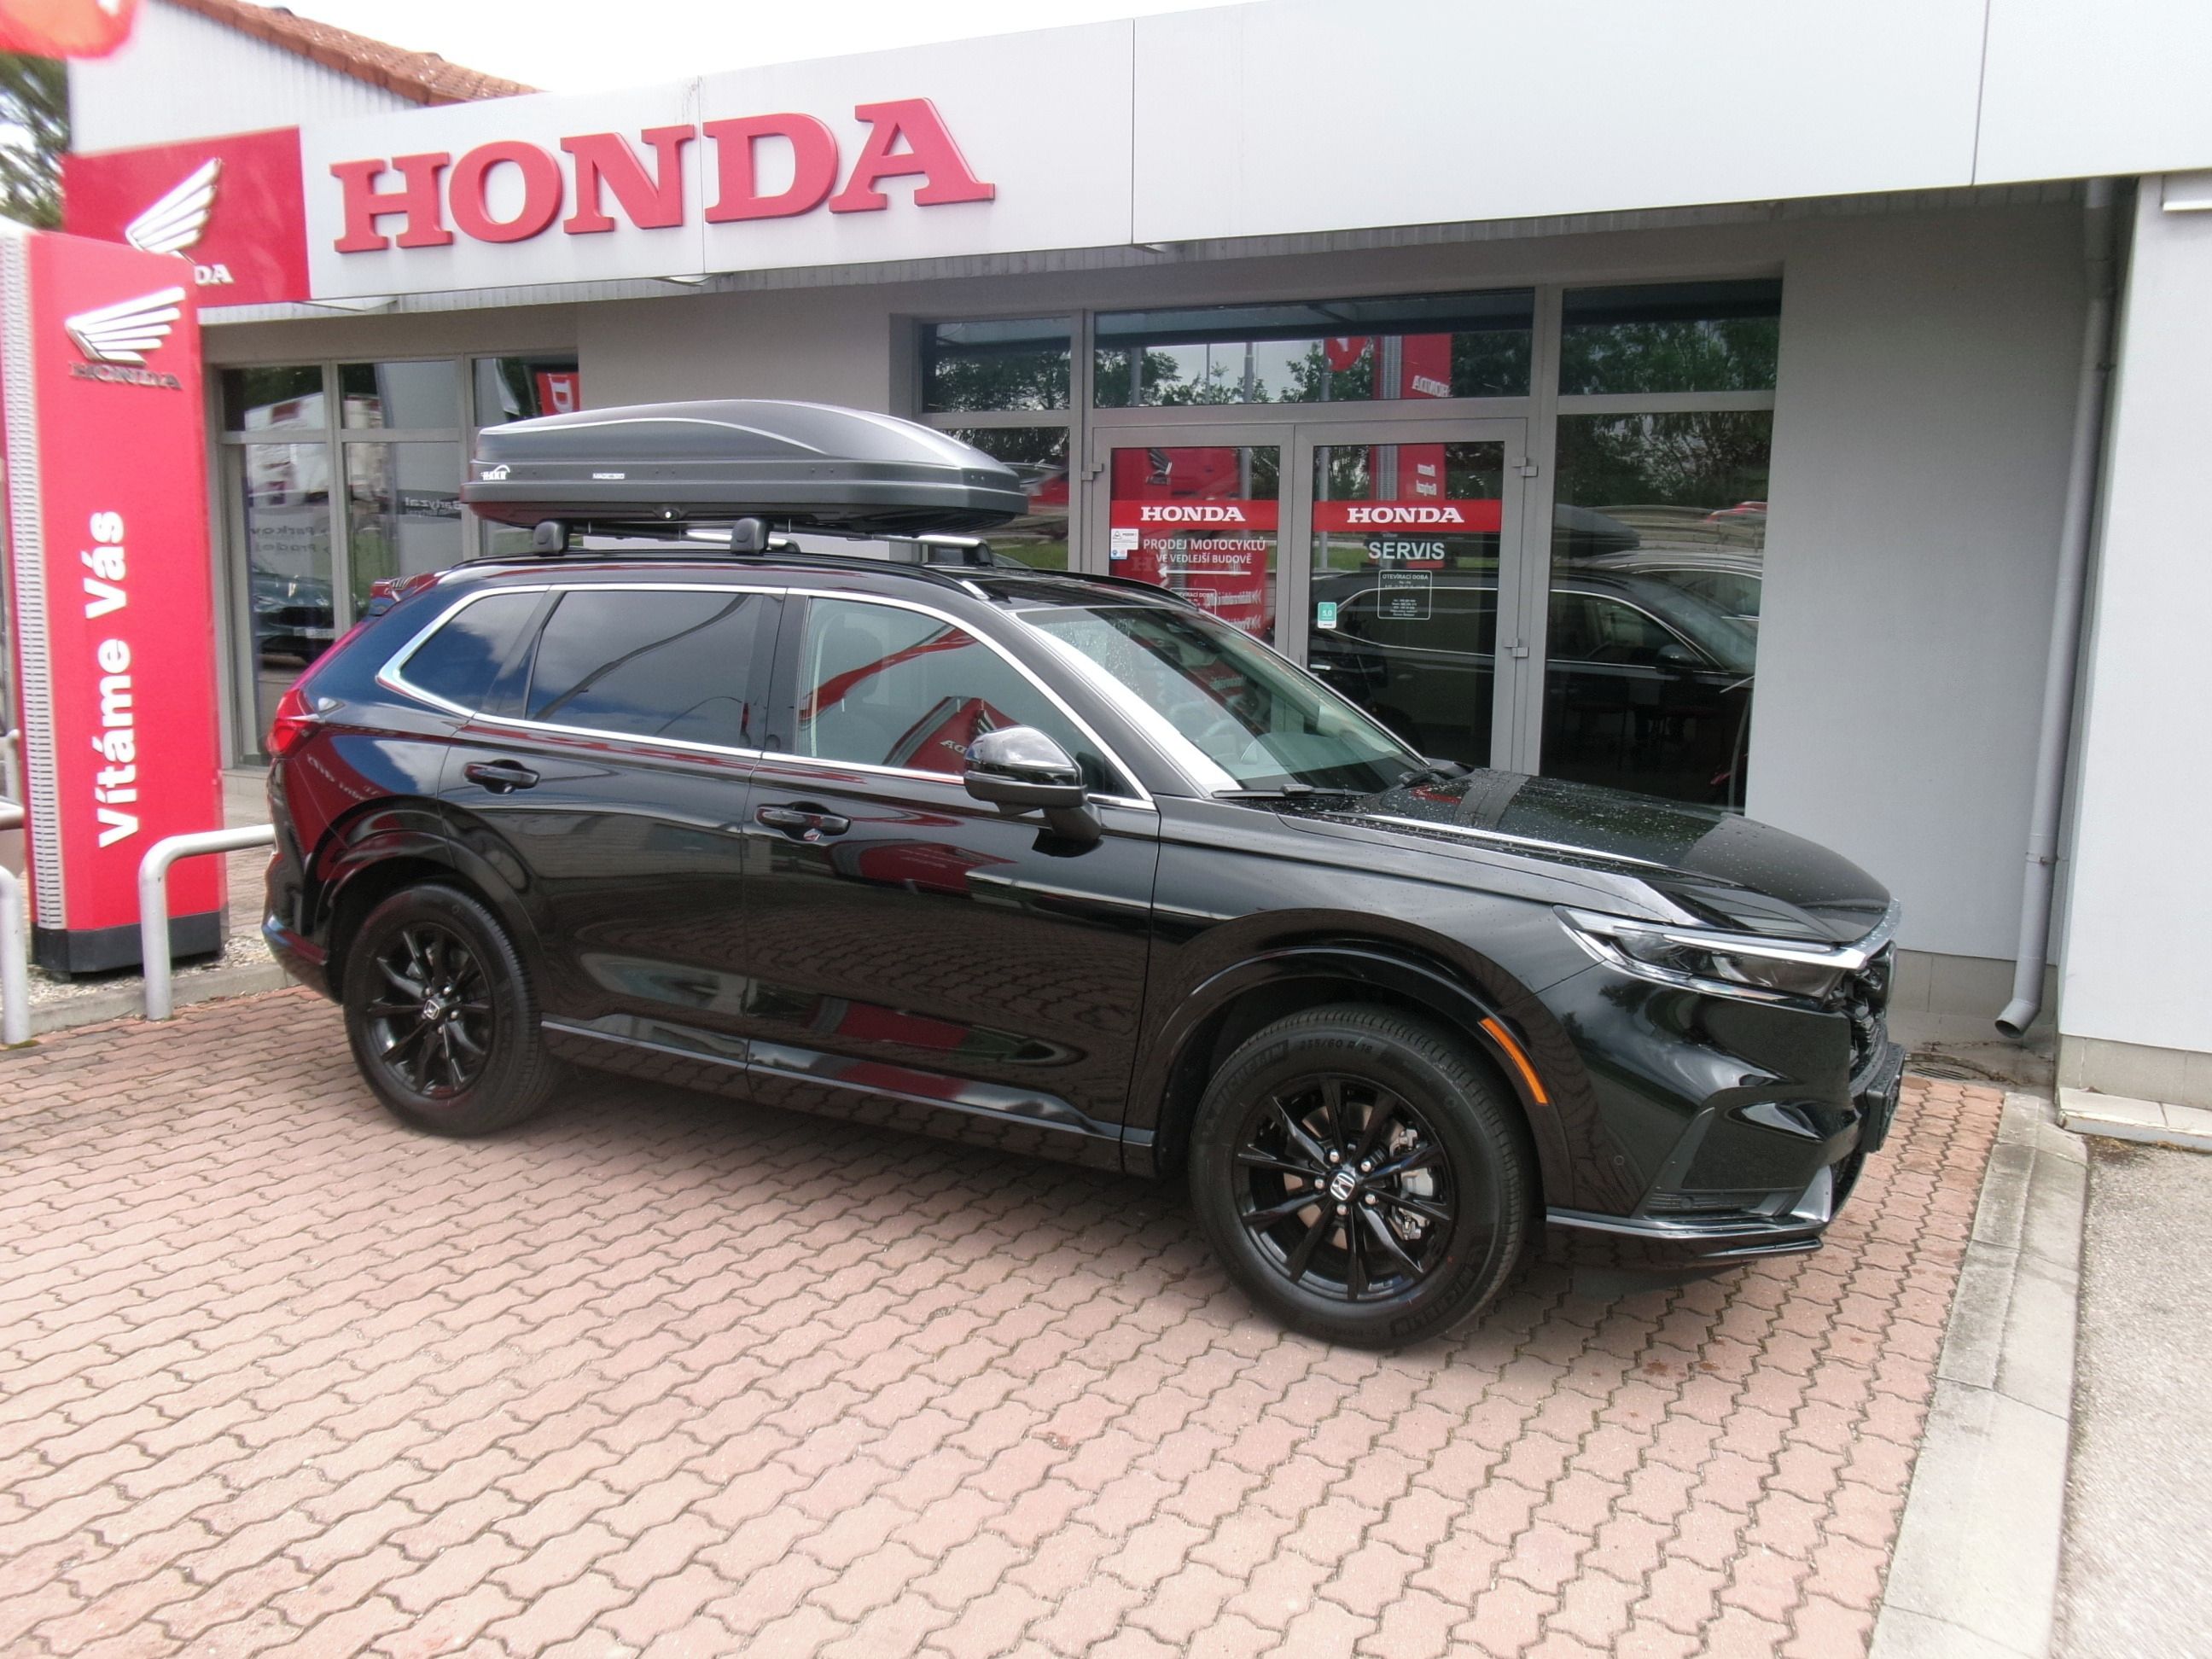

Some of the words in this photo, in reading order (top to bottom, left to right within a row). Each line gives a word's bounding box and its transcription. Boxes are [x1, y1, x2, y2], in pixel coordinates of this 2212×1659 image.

[330, 98, 995, 253] HONDA
[68, 361, 182, 390] HONDA
[1141, 506, 1246, 521] HONDA
[1347, 508, 1464, 523] HONDA
[1144, 538, 1187, 550] PRODEJ
[1190, 536, 1266, 550] MOTOCYKLŮ
[1368, 541, 1445, 560] SERVIS
[81, 511, 126, 620] Vás
[1156, 554, 1168, 563] VE
[1170, 552, 1210, 563] VEDLEJŠÍ
[1213, 553, 1252, 564] BUDOVĚ
[92, 638, 139, 848] Vítáme
